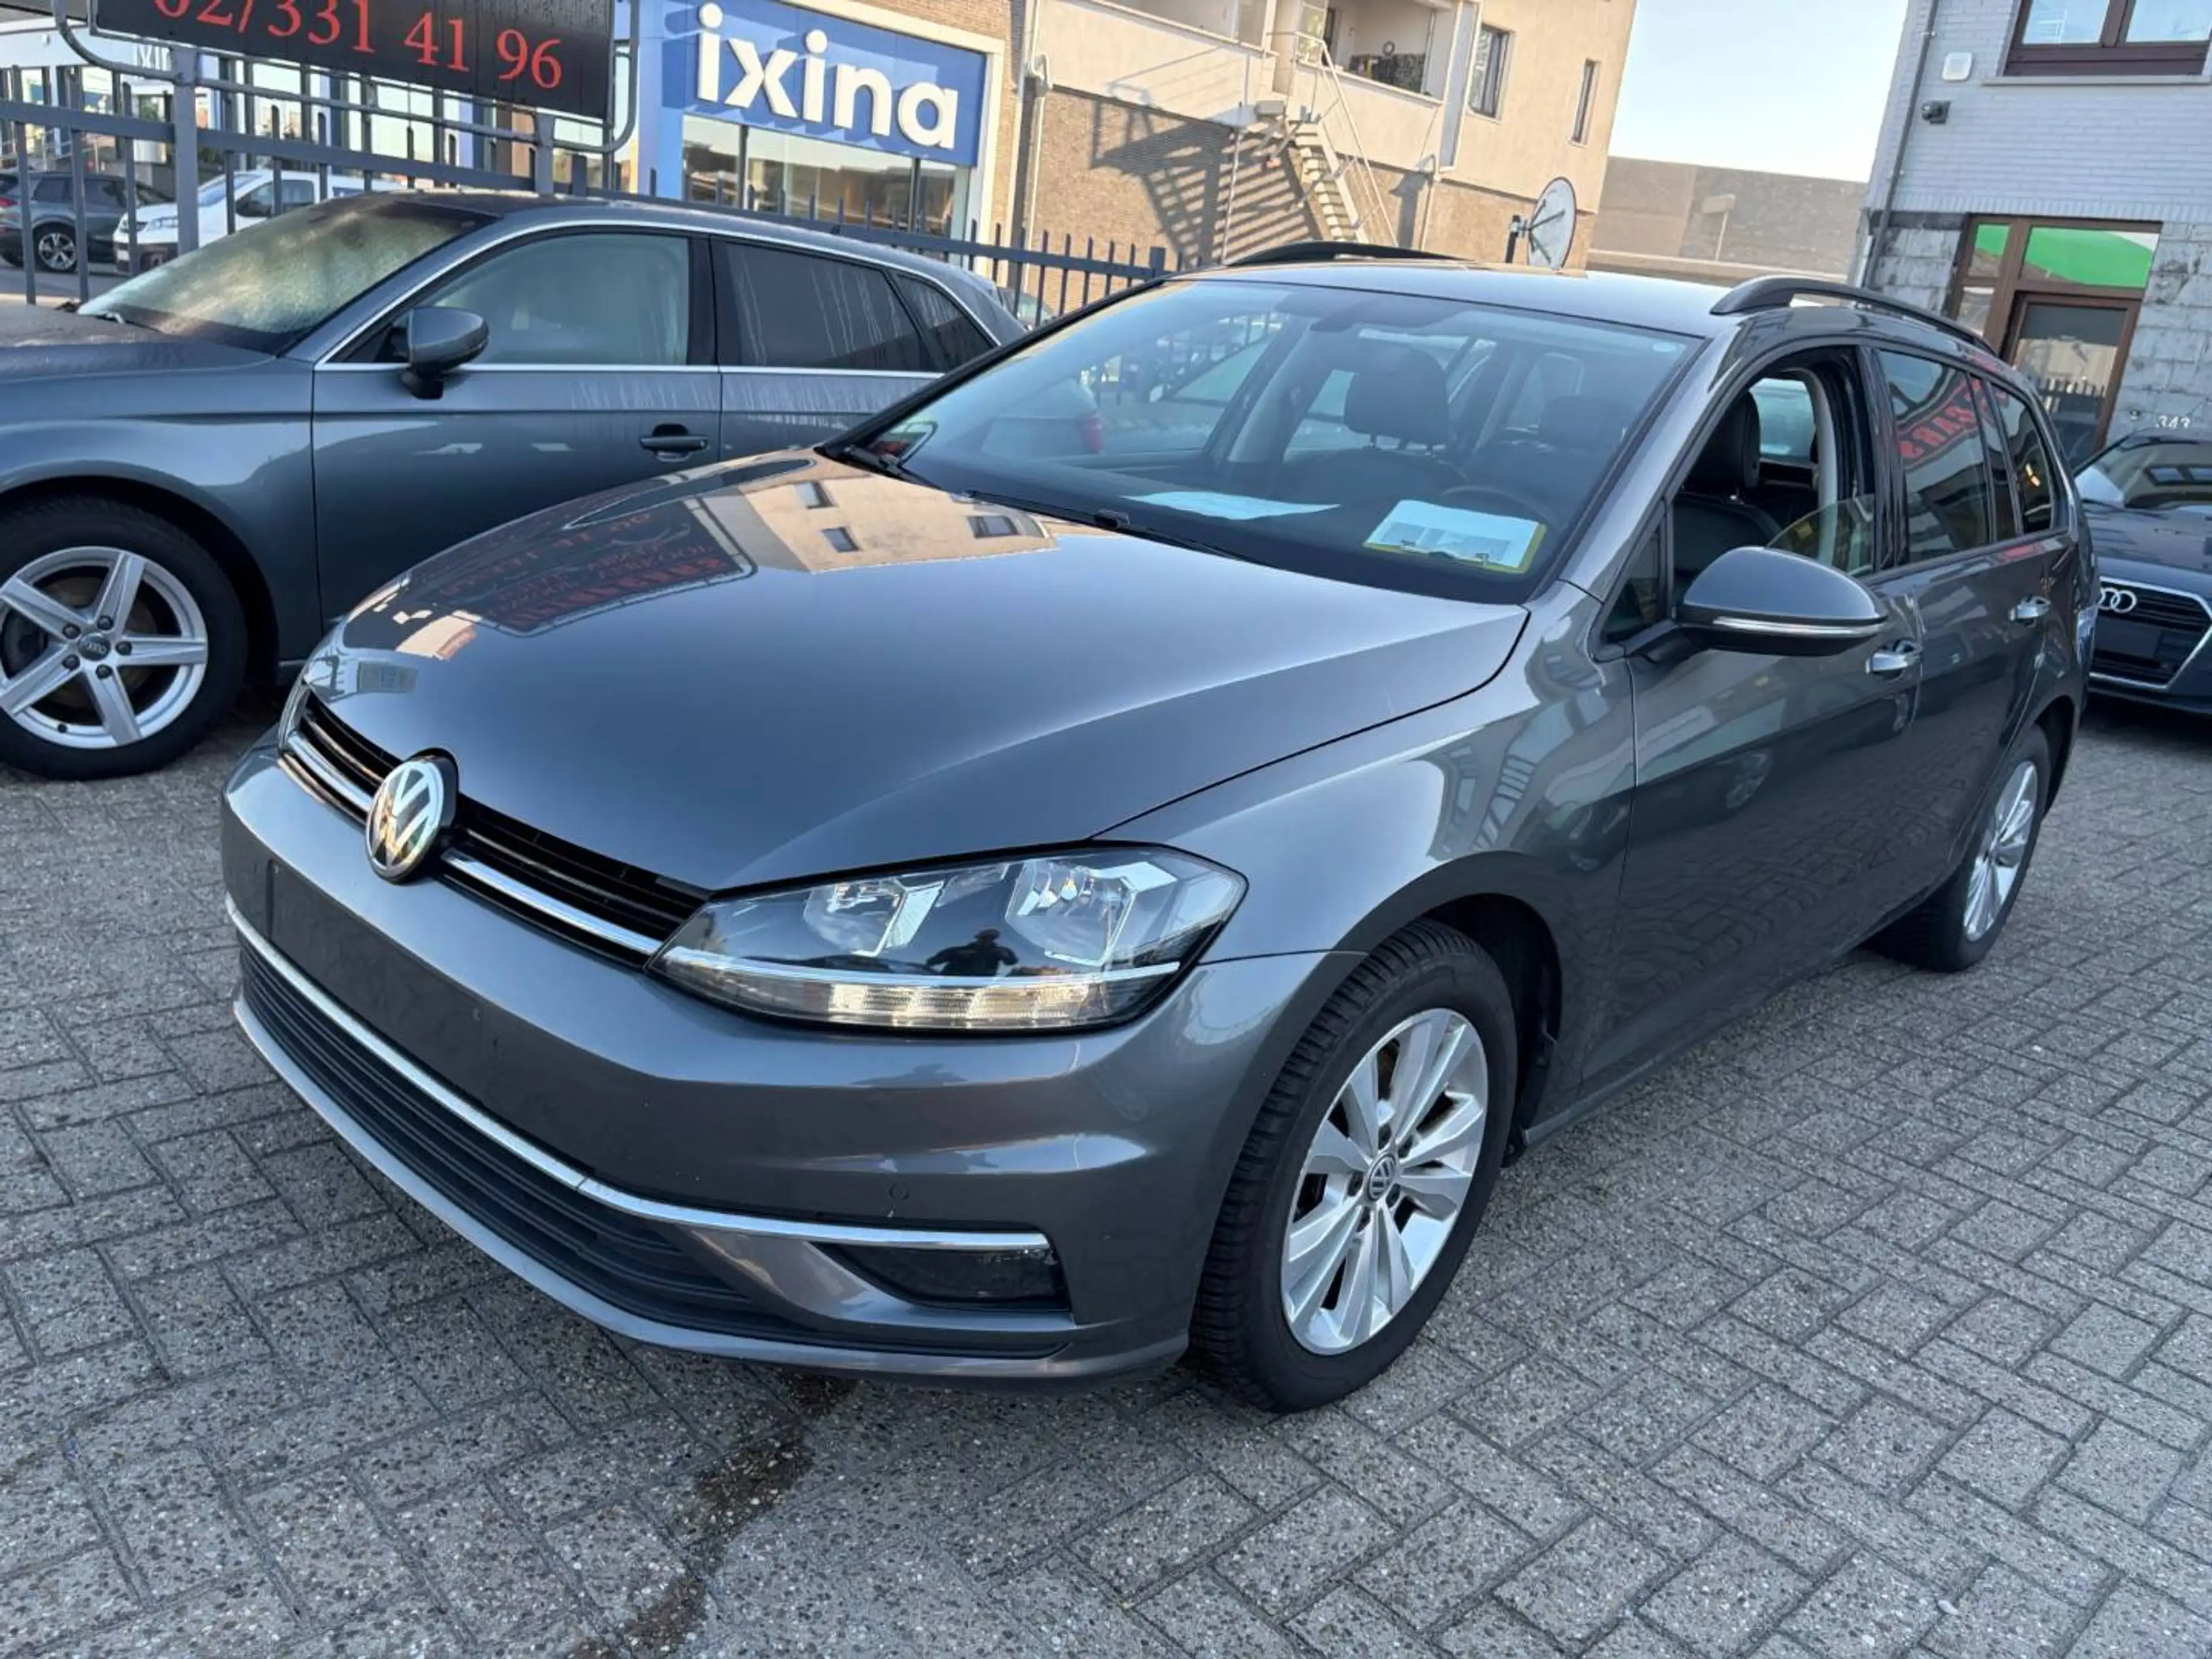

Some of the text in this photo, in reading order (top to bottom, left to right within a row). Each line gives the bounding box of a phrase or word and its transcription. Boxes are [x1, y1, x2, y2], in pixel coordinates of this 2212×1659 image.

[403, 12, 469, 72] 41
[497, 29, 562, 88] 96
[697, 2, 959, 149] ixina
